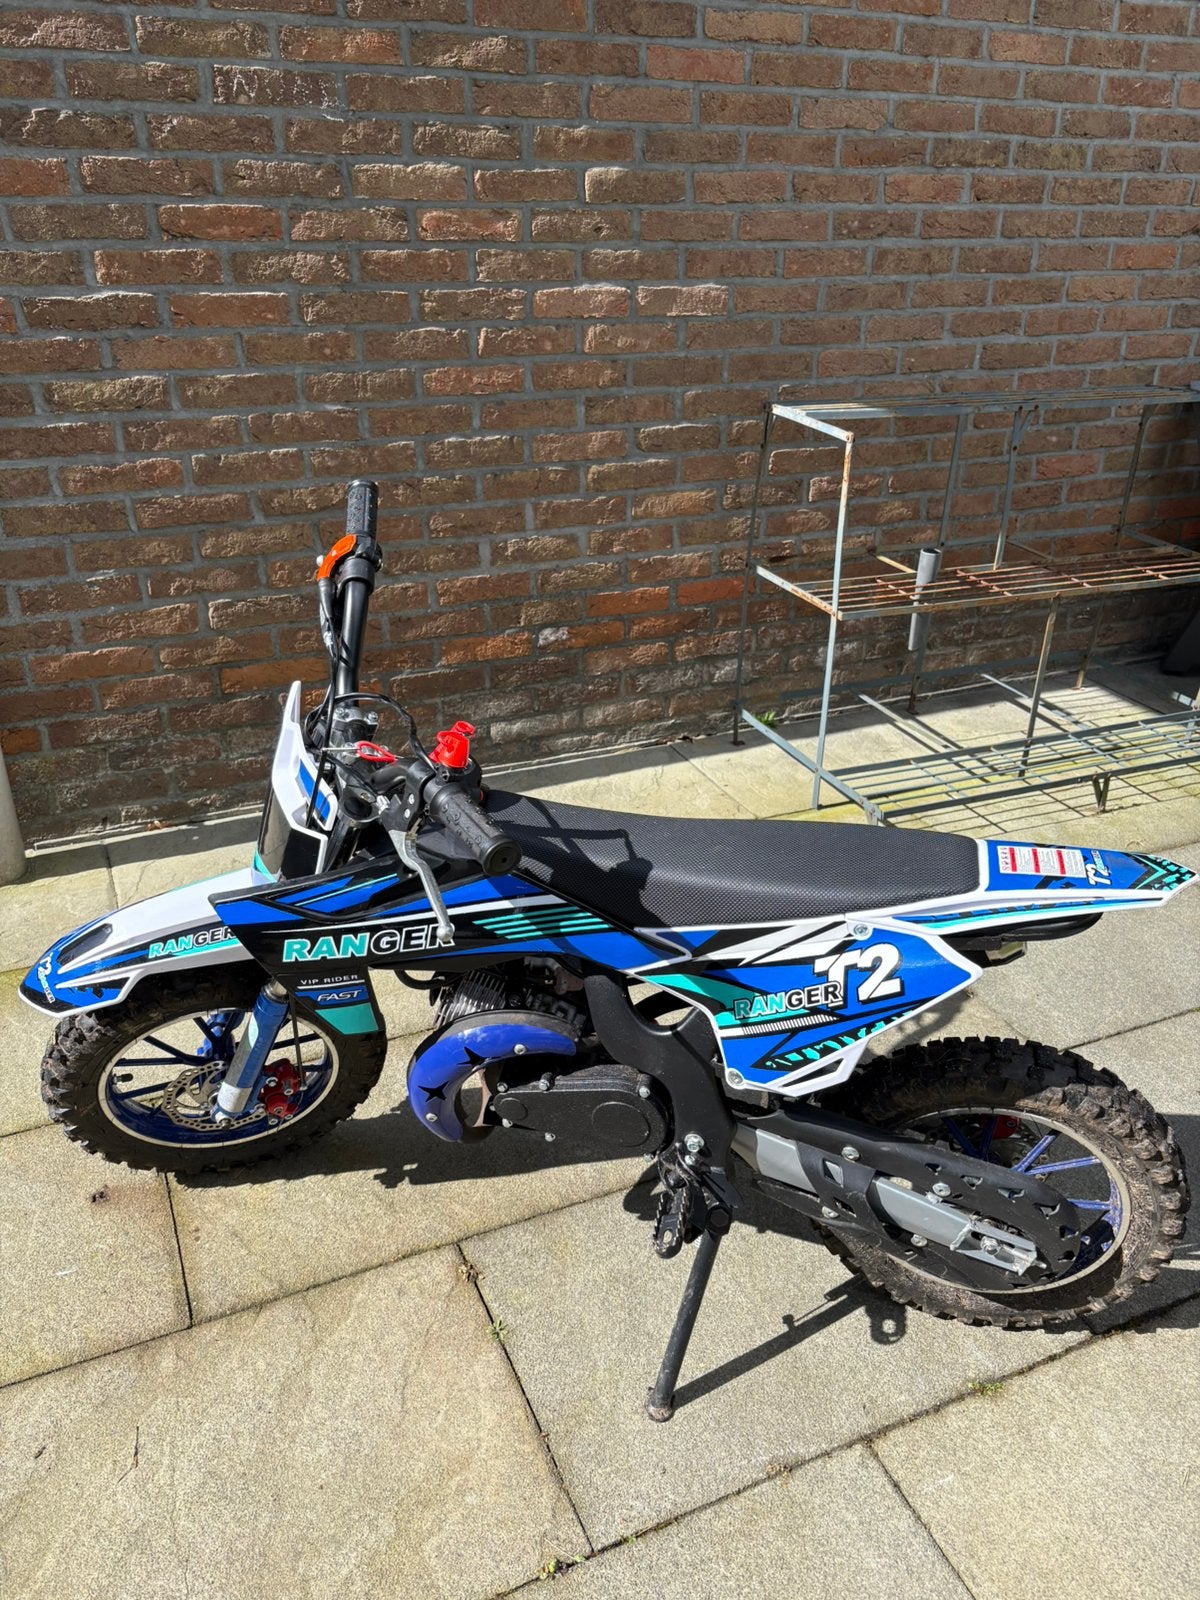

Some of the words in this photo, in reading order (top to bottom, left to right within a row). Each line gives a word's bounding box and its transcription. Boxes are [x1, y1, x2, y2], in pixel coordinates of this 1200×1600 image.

[282, 923, 455, 962] RANGER
[324, 974, 358, 983] RIDER
[813, 943, 901, 1005] T2
[317, 990, 362, 1002] FAST
[734, 982, 842, 1019] RANGER
